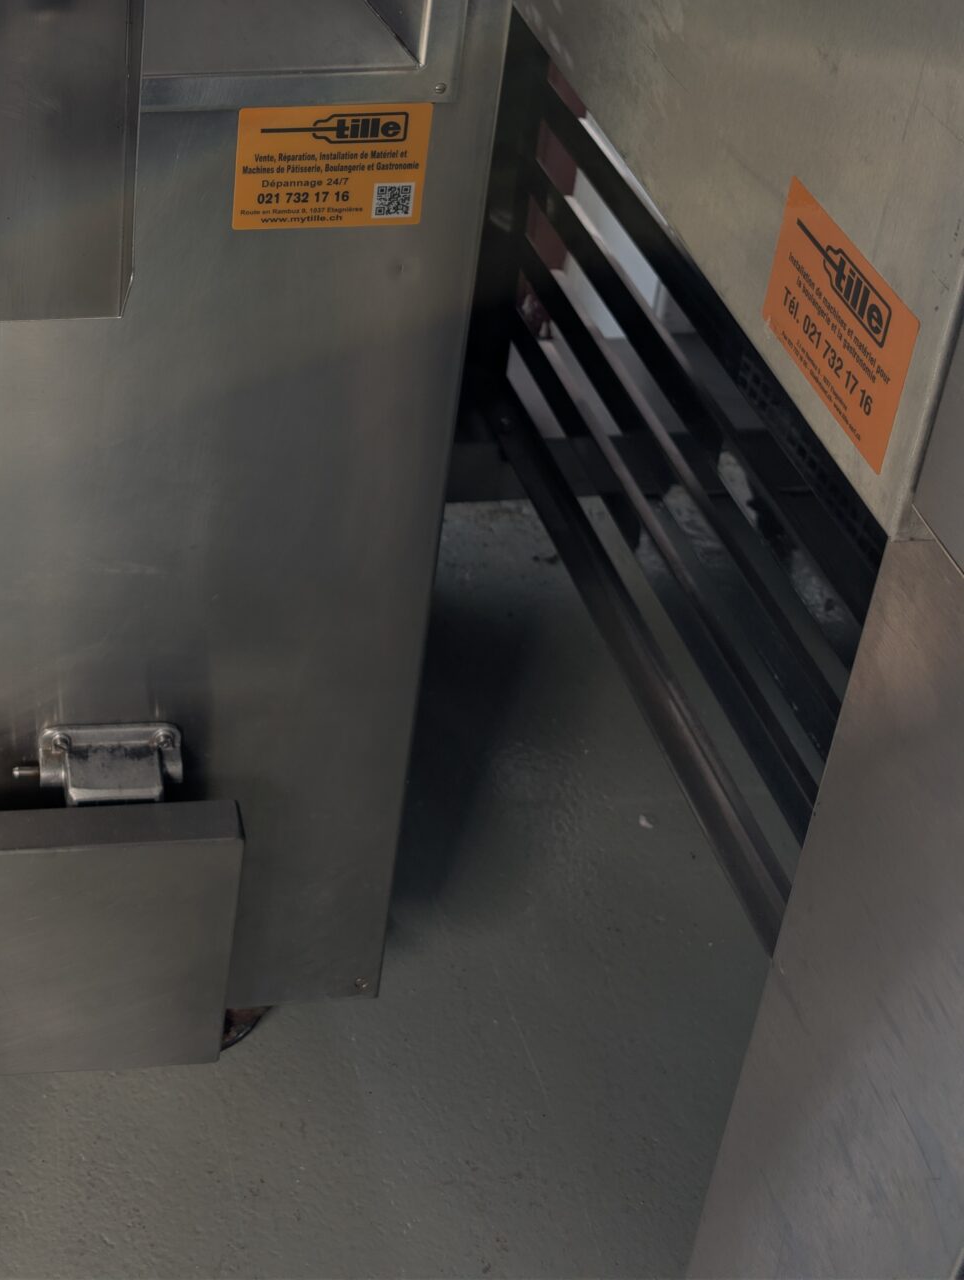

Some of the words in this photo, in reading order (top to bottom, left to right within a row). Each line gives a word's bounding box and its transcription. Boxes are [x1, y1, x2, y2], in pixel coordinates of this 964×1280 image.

[336, 118, 402, 139] tille
[254, 153, 276, 163] Vente,
[278, 152, 317, 163] Réparation,
[320, 151, 358, 161] Installation
[360, 151, 369, 160] de
[370, 150, 398, 160] Matériel
[400, 150, 407, 158] et
[242, 165, 275, 175] Machines
[276, 165, 285, 173] de
[324, 163, 365, 173] Boulangerie
[367, 163, 374, 171] et
[376, 162, 420, 171] Gastronomie
[261, 179, 323, 189] Dépannage
[326, 178, 349, 187] 24/7
[257, 192, 280, 205] 021
[285, 191, 309, 204] 732
[314, 191, 329, 203] 17
[335, 190, 350, 202] 16
[261, 214, 343, 224] www.mytille.ch
[835, 257, 883, 335] tille
[782, 286, 800, 323] Tél.
[802, 314, 822, 349] 021
[822, 340, 844, 378] 732
[845, 370, 859, 395] 17
[859, 389, 872, 416] 16
[876, 365, 891, 385] pour
